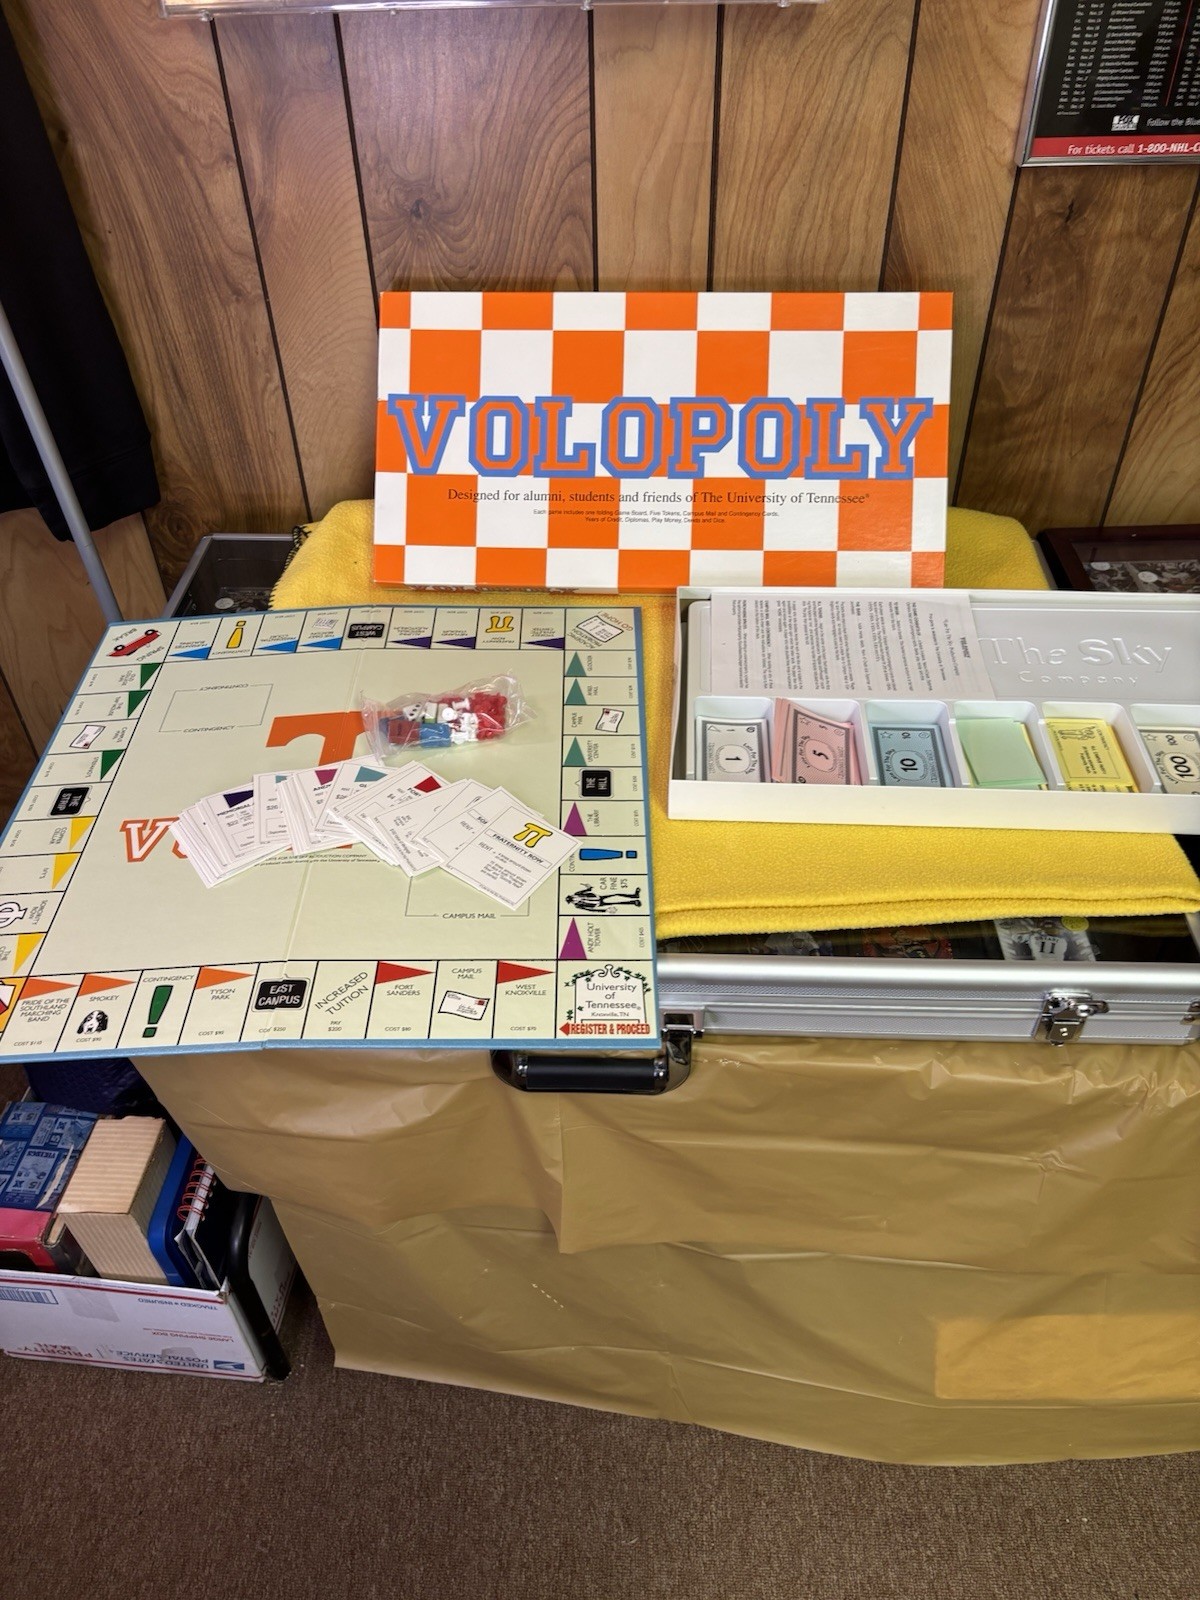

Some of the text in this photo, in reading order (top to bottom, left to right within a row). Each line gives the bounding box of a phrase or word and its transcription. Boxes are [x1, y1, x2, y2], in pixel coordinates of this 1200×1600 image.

[1067, 145, 1083, 155] For
[1085, 144, 1115, 155] tickets
[1117, 143, 1135, 154] call
[387, 393, 934, 479] VOLOPOLY
[448, 489, 500, 503] Designed
[504, 490, 519, 501] for
[523, 490, 566, 503] alumni,
[569, 491, 615, 502] students
[619, 491, 639, 502] and
[643, 491, 681, 503] friends
[685, 492, 699, 503] of
[700, 492, 723, 503] The
[727, 492, 786, 506] University
[790, 492, 804, 503] of
[351, 624, 383, 632] CAMPUS
[621, 623, 633, 632] GO
[112, 627, 138, 642] BREAK
[567, 632, 595, 649] ACADEMIC
[137, 645, 165, 662] SPRING
[978, 637, 1172, 673] The Sky
[1018, 670, 1138, 687] Company
[901, 731, 911, 740] 10
[1165, 734, 1179, 746] 100
[812, 749, 830, 761] 5
[899, 758, 918, 773] 10
[1169, 755, 1196, 779] 100
[585, 777, 596, 789] THE
[597, 776, 608, 790] HILL
[57, 792, 72, 811] STRIP
[69, 795, 82, 807] THE
[216, 803, 251, 817] MEMORIAL
[50, 827, 61, 845] CELLAR
[56, 827, 67, 845] COPPER
[478, 841, 494, 852] RENT
[492, 833, 544, 865] FRATERNITY ROW
[600, 876, 608, 890] CAR
[609, 877, 618, 891] FINE
[620, 879, 628, 889] $75
[29, 905, 39, 920] ROW
[32, 900, 49, 926] SORORITY
[587, 922, 595, 937] HOLT
[1039, 941, 1056, 954] 11
[451, 967, 483, 975] CAMPUS
[142, 973, 195, 984] CONTINGENCY
[269, 984, 296, 995] EAST
[314, 971, 369, 1010] INCREASED
[386, 989, 421, 997] SANDERS
[505, 989, 547, 997] KNOXVILLE
[586, 983, 638, 993] University
[89, 994, 120, 1002] SMOKEY
[211, 993, 231, 1001] PARK
[258, 995, 301, 1007] CAMPUS
[325, 985, 370, 1016] TUITION
[604, 991, 617, 1000] of
[20, 1003, 68, 1012] SOUTHLAND
[20, 1009, 62, 1018] MARCHING
[570, 1023, 651, 1035] REGISTER & PROCEED
[138, 1297, 219, 1311] TRACKED INSURED
[175, 1332, 211, 1340] SHIPPING
[212, 1334, 234, 1342] LARGE
[22, 1345, 94, 1358] PRIORITY
[34, 1341, 72, 1351] MAIL
[116, 1350, 209, 1364] POSTAL SERVICE
[122, 1355, 209, 1369] UNITED STATES
